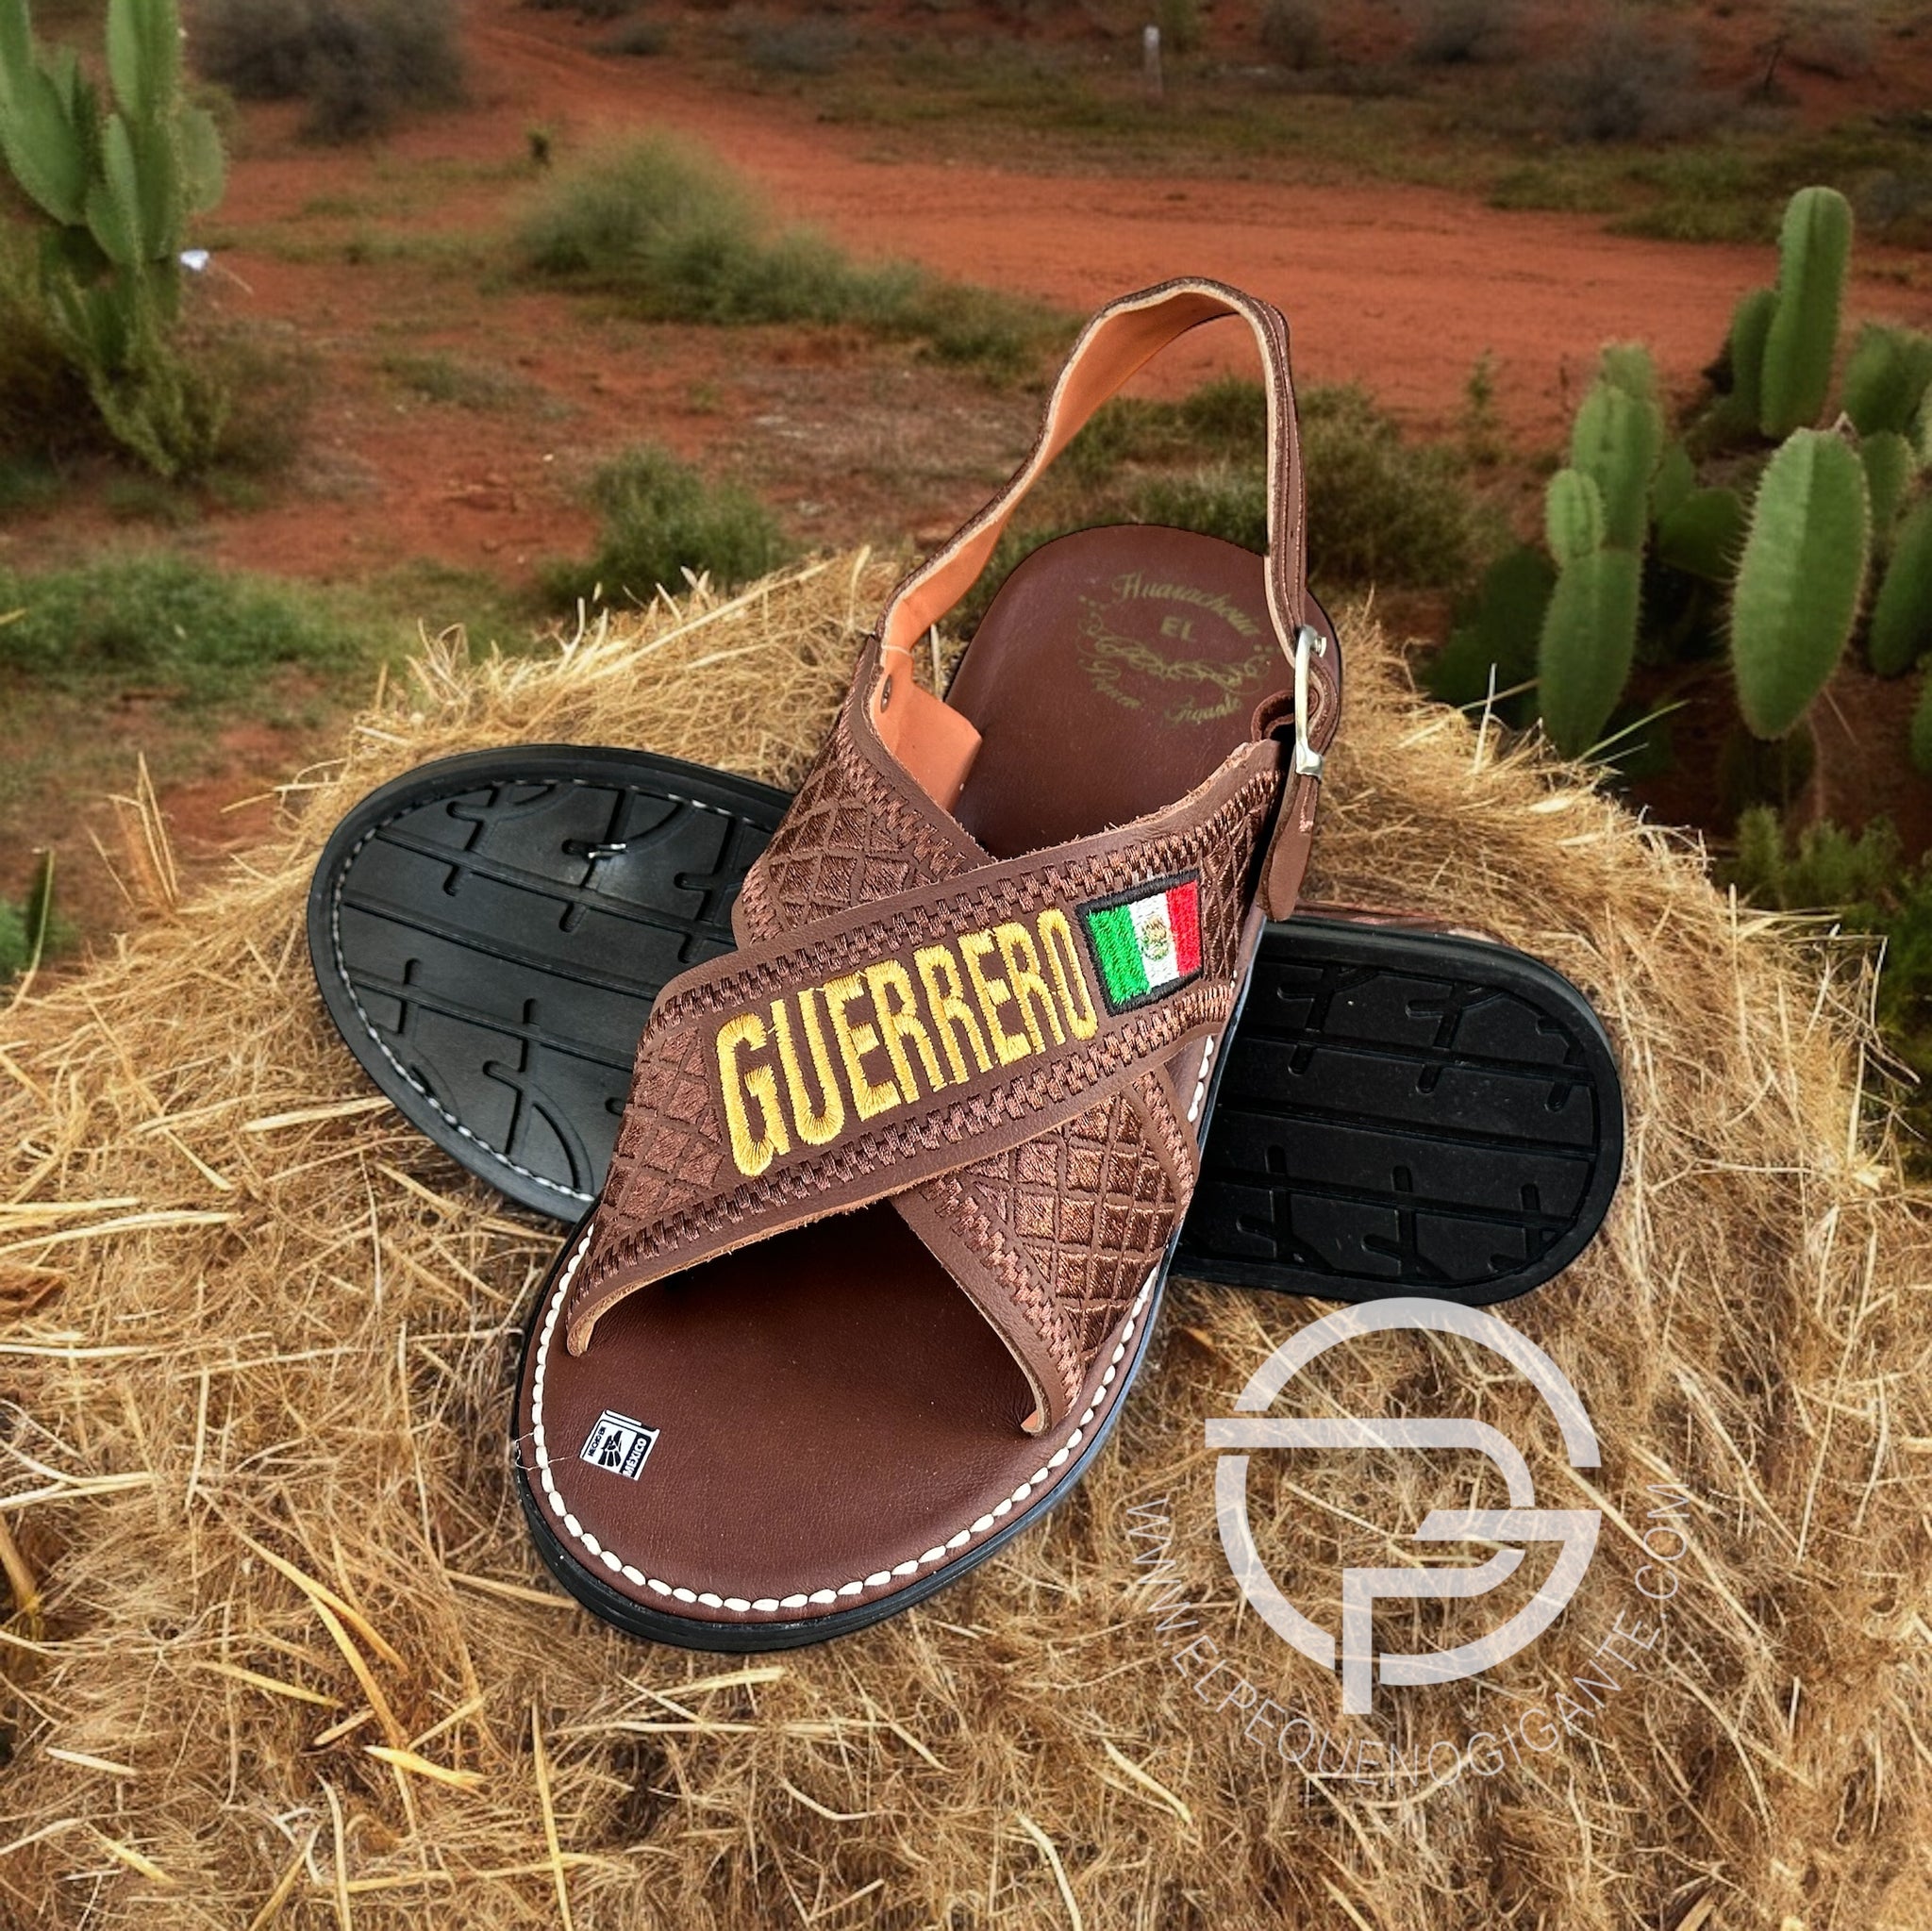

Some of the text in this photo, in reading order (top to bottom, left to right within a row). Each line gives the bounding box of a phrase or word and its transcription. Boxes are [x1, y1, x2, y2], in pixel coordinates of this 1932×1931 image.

[1159, 616, 1197, 642] EL
[714, 907, 1099, 1178] GUERRERO
[588, 1434, 602, 1457] HECHO
